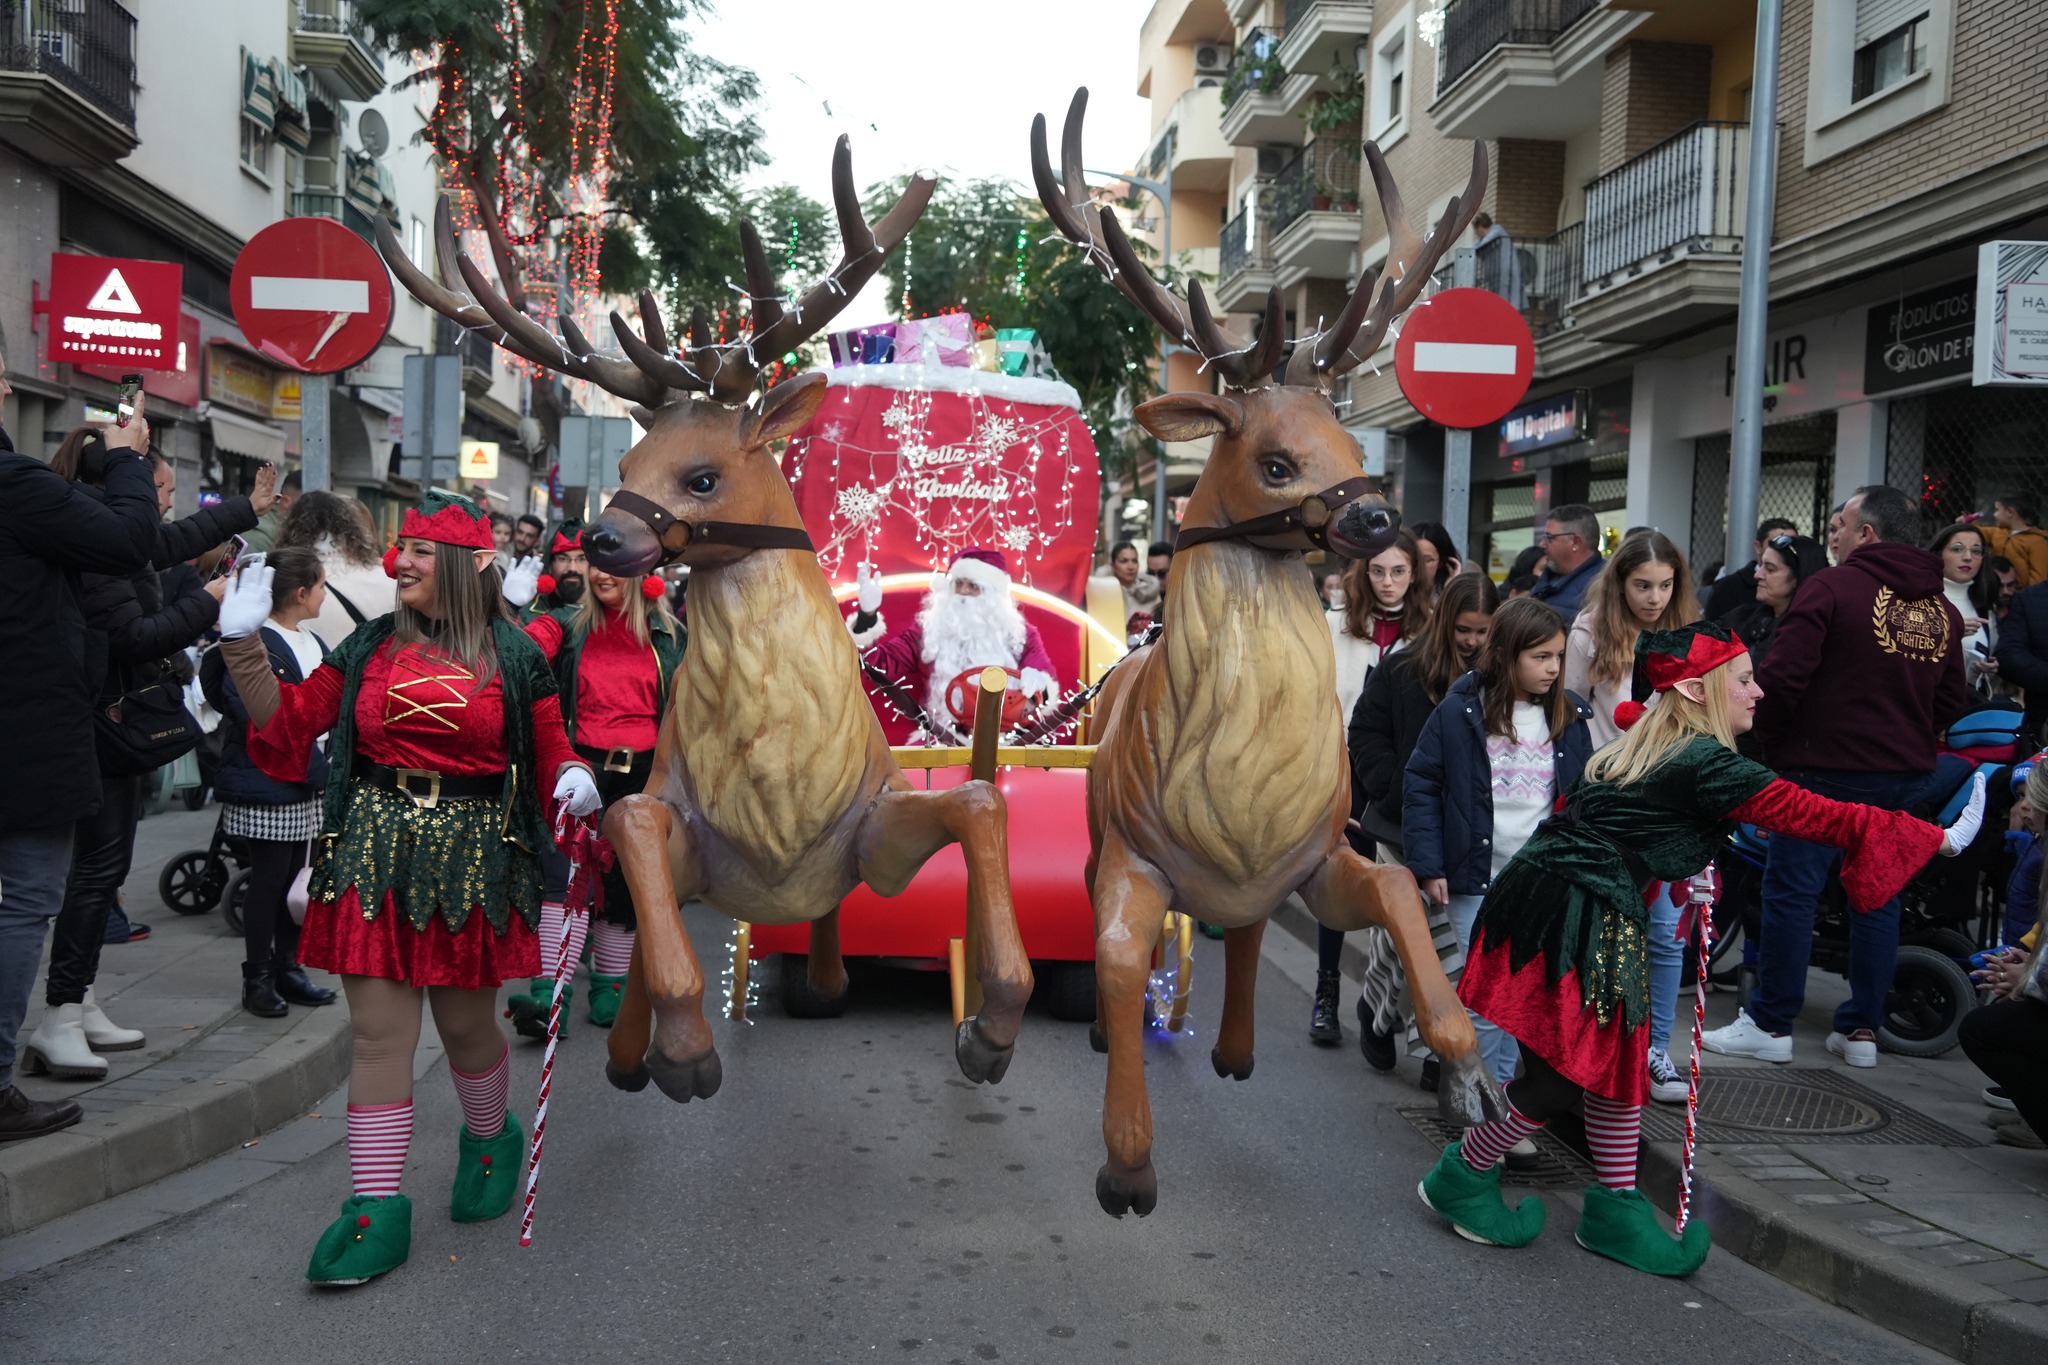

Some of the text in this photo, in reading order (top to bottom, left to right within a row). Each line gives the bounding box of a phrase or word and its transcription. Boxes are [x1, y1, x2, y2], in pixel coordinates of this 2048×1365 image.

[2022, 296, 2048, 308] HA
[1889, 293, 1969, 334] PRODUCTOS
[62, 341, 161, 358] PERFUMERIAS
[1943, 338, 1962, 361] DE
[1506, 404, 1566, 443] Mil Digital
[914, 477, 1010, 502] Navidad
[1912, 612, 1922, 621] VS
[1896, 631, 1935, 650] FIGHTERS
